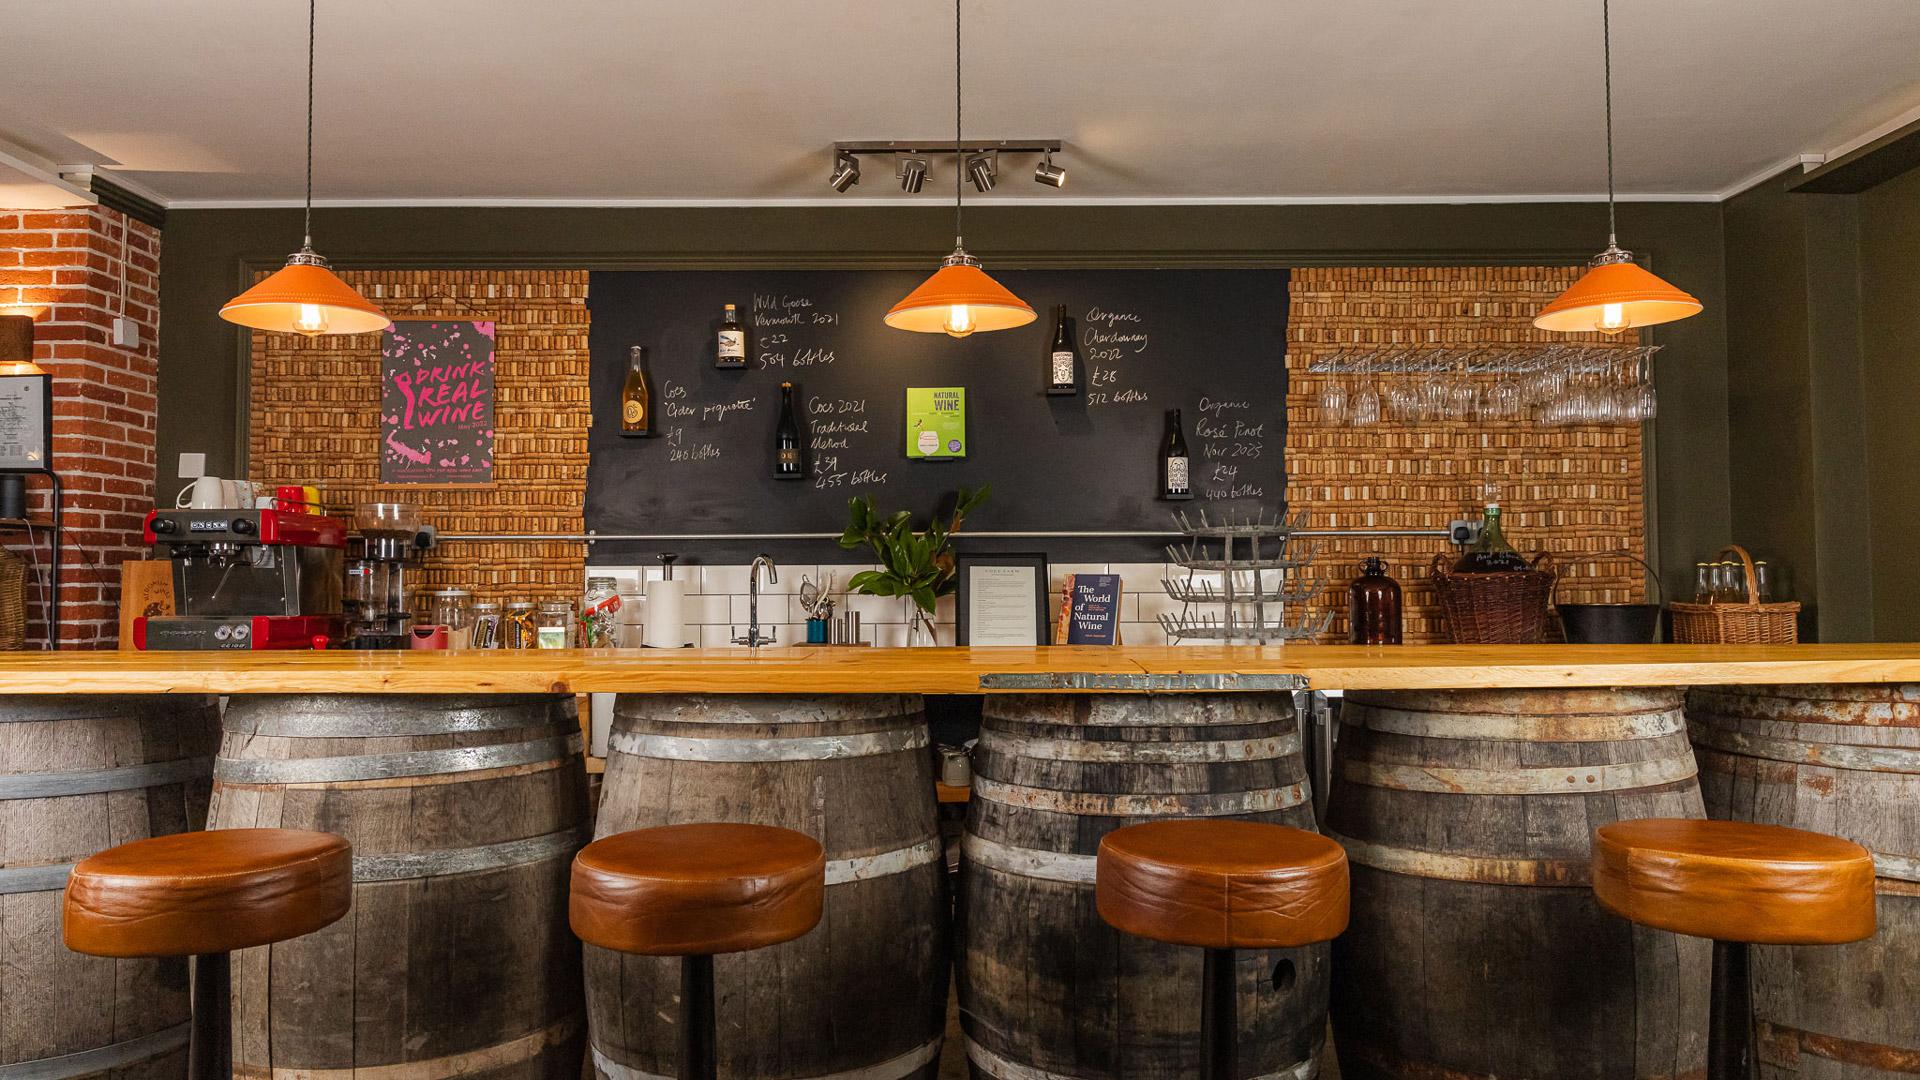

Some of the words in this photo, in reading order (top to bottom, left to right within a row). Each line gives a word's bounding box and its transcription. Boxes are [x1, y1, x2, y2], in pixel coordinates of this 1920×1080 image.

[782, 295, 813, 315] Goose
[812, 312, 838, 326] 2021
[1086, 307, 1141, 327] Organic
[1084, 327, 1147, 352] Chardonnay
[760, 353, 784, 370] 504
[793, 348, 835, 366] bottles
[1090, 347, 1122, 360] 2022
[415, 361, 486, 385] DRINK
[1092, 365, 1117, 386] £28
[418, 378, 488, 408] REAL
[1088, 393, 1108, 405] 512
[1114, 389, 1148, 403] bottles
[838, 399, 865, 413] 2021
[934, 399, 959, 411] WINE
[1199, 397, 1249, 417] Organic
[417, 401, 488, 428] WINE
[810, 419, 868, 434] Traditional
[1196, 418, 1228, 438] Rosé
[1234, 420, 1263, 438] Pinot
[691, 443, 720, 460] bottles
[1203, 443, 1227, 459] Noir
[816, 472, 848, 489] 455
[851, 469, 887, 485] bottles
[1206, 488, 1227, 500] 440
[1231, 484, 1263, 499] bottles
[1078, 585, 1094, 593] The
[1084, 594, 1111, 603] World
[1074, 603, 1085, 611] of
[1074, 612, 1109, 620] Natural
[1078, 621, 1102, 630] Wine
